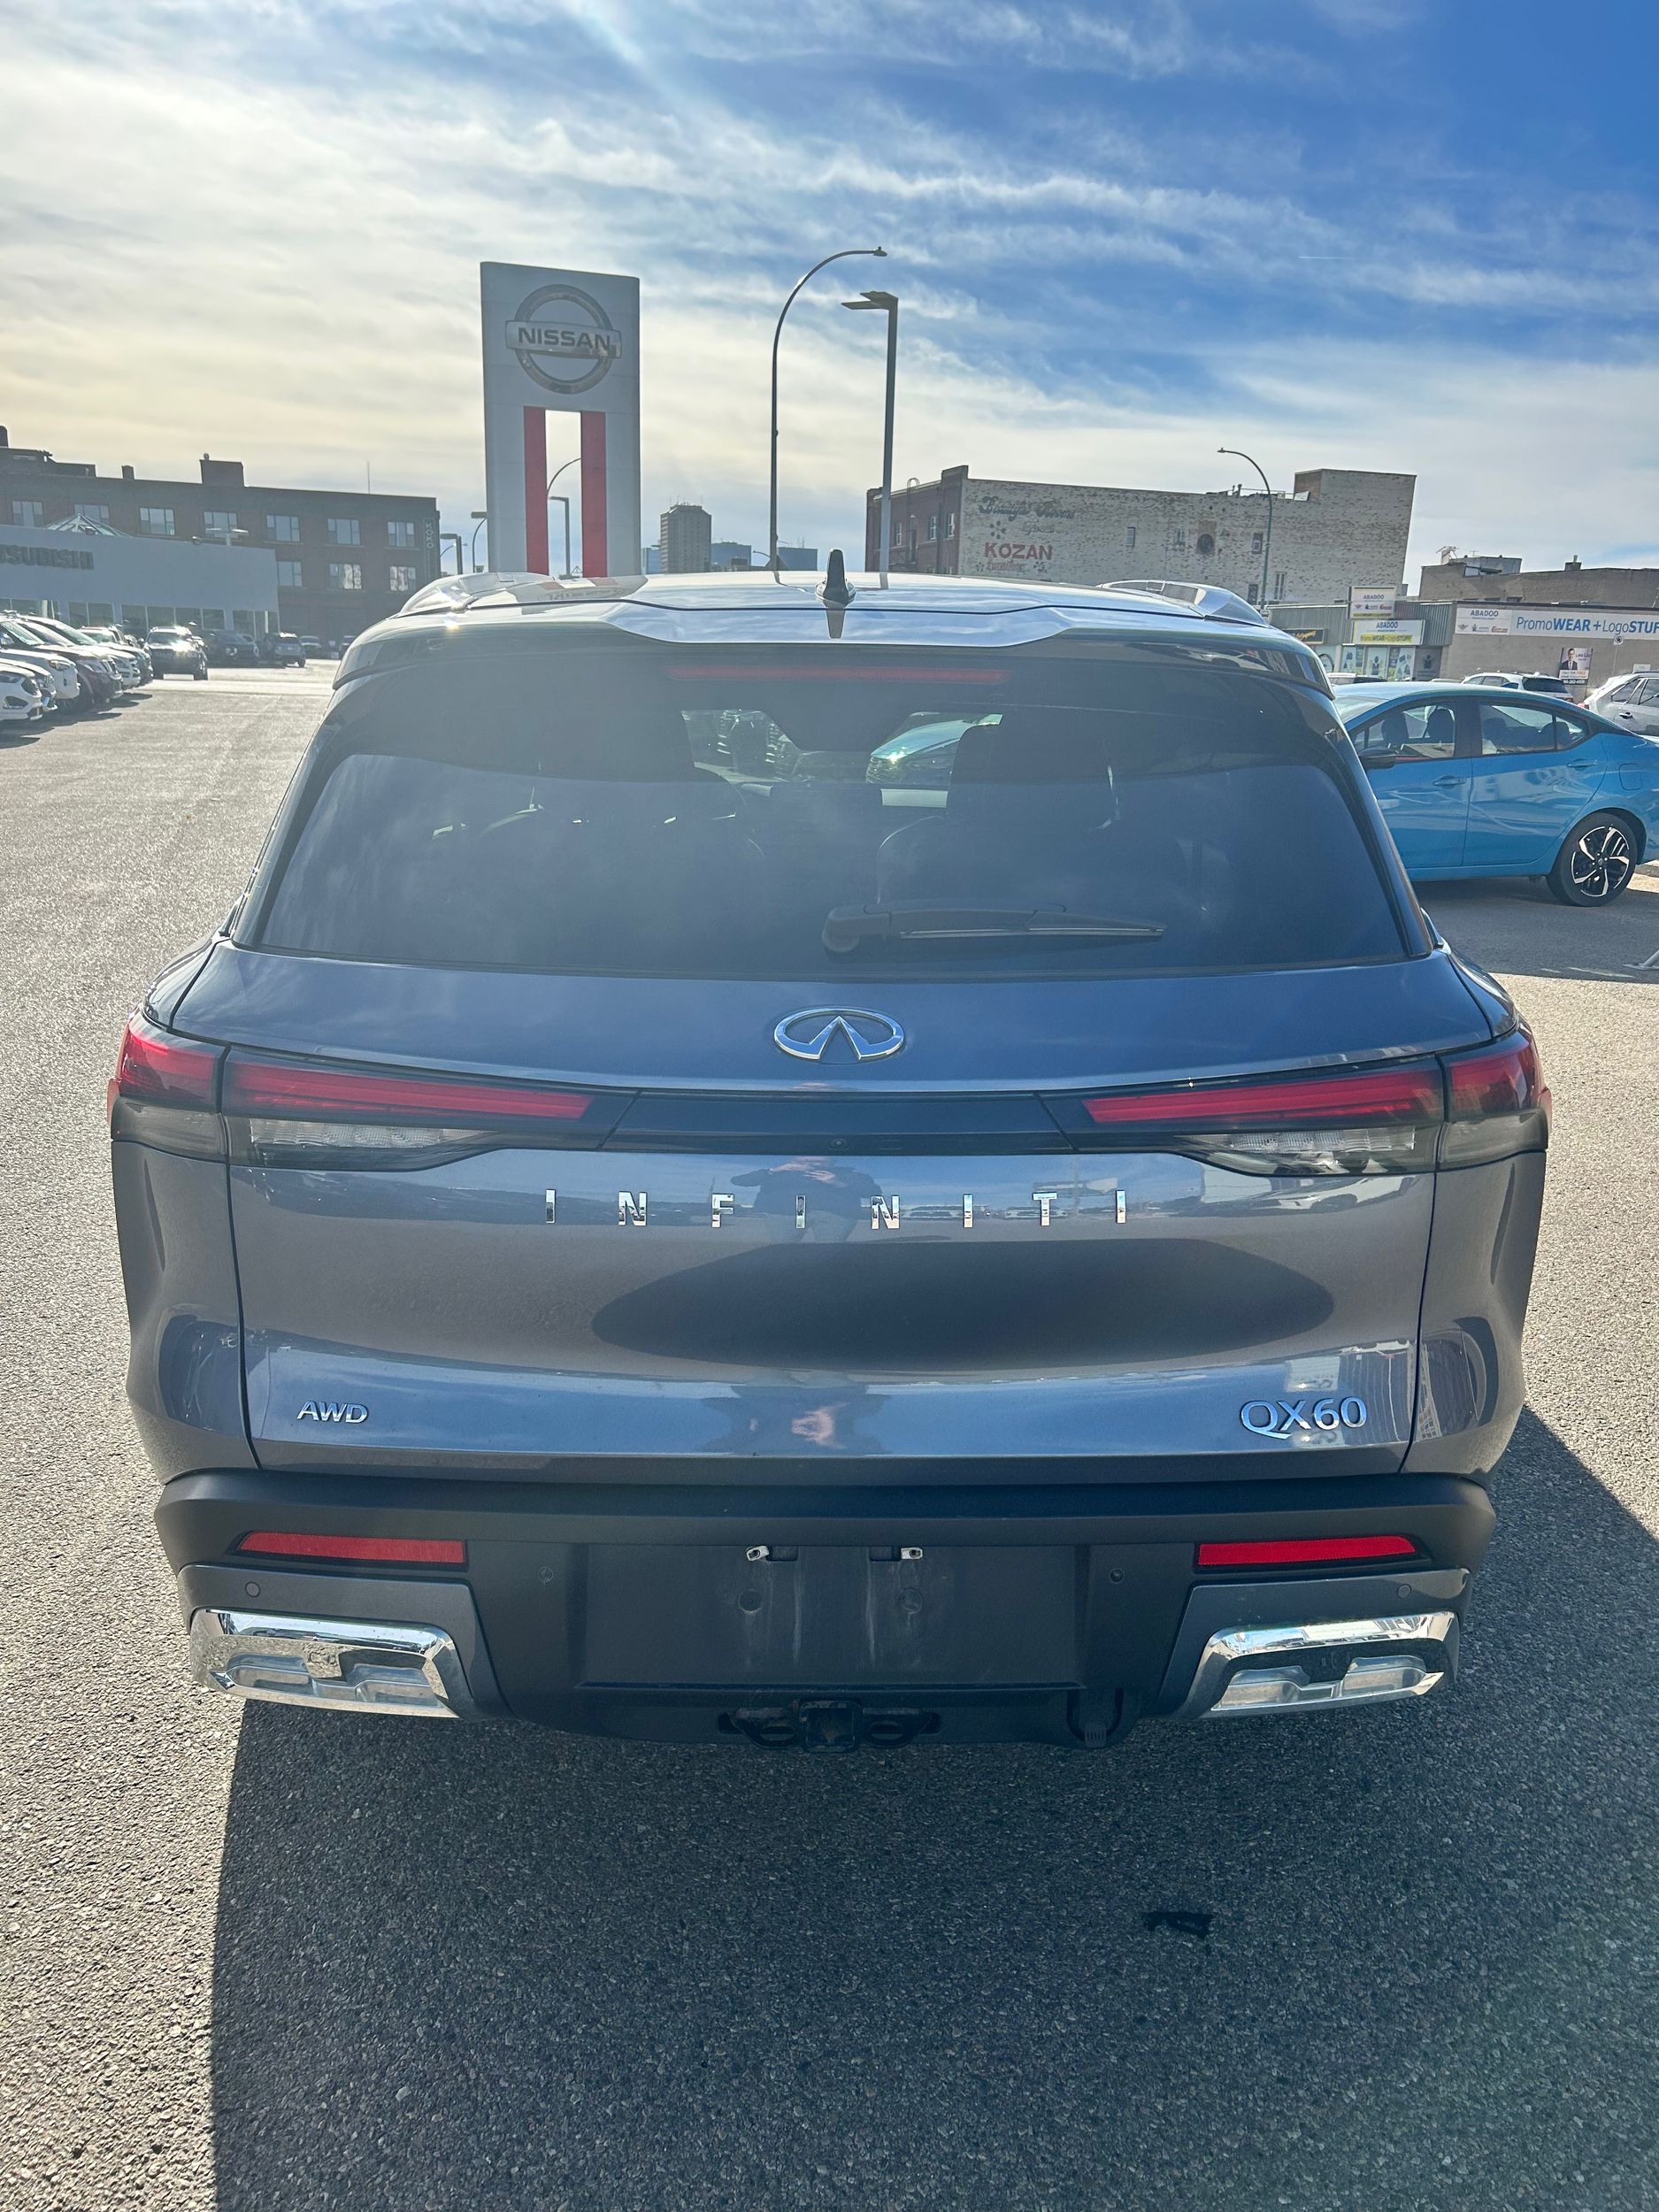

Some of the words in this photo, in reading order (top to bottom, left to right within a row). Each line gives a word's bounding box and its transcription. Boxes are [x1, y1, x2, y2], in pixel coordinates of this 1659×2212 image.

[518, 327, 611, 351] NISSAN
[984, 541, 1053, 560] KOZAN
[546, 1188, 1127, 1230] INFINITI
[296, 1401, 369, 1424] AWD
[1240, 1396, 1367, 1440] QX60
